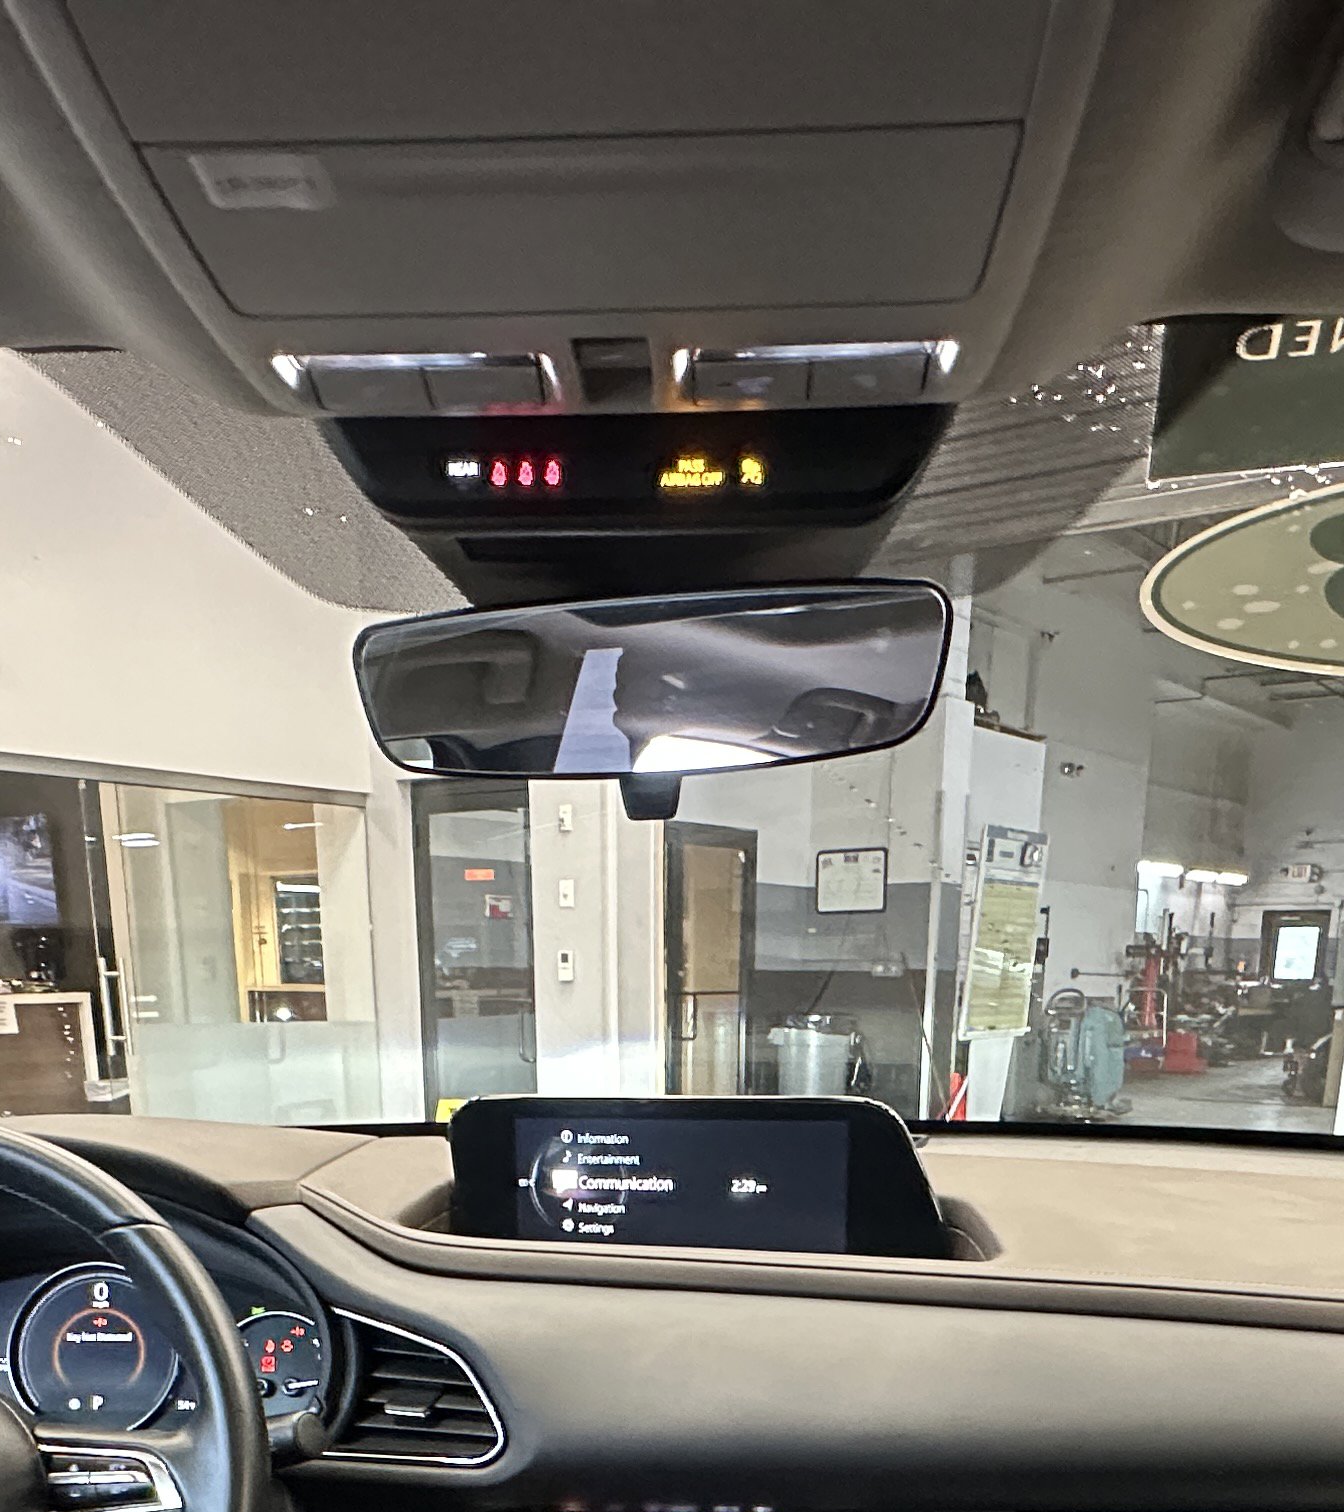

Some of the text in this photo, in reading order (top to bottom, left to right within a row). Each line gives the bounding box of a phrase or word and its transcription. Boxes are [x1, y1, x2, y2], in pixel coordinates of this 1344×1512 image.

[576, 1132, 630, 1147] Information
[576, 1152, 641, 1166] Entertainment
[577, 1174, 675, 1193] Communication
[577, 1201, 626, 1215] Navigation
[577, 1220, 615, 1236] Settings
